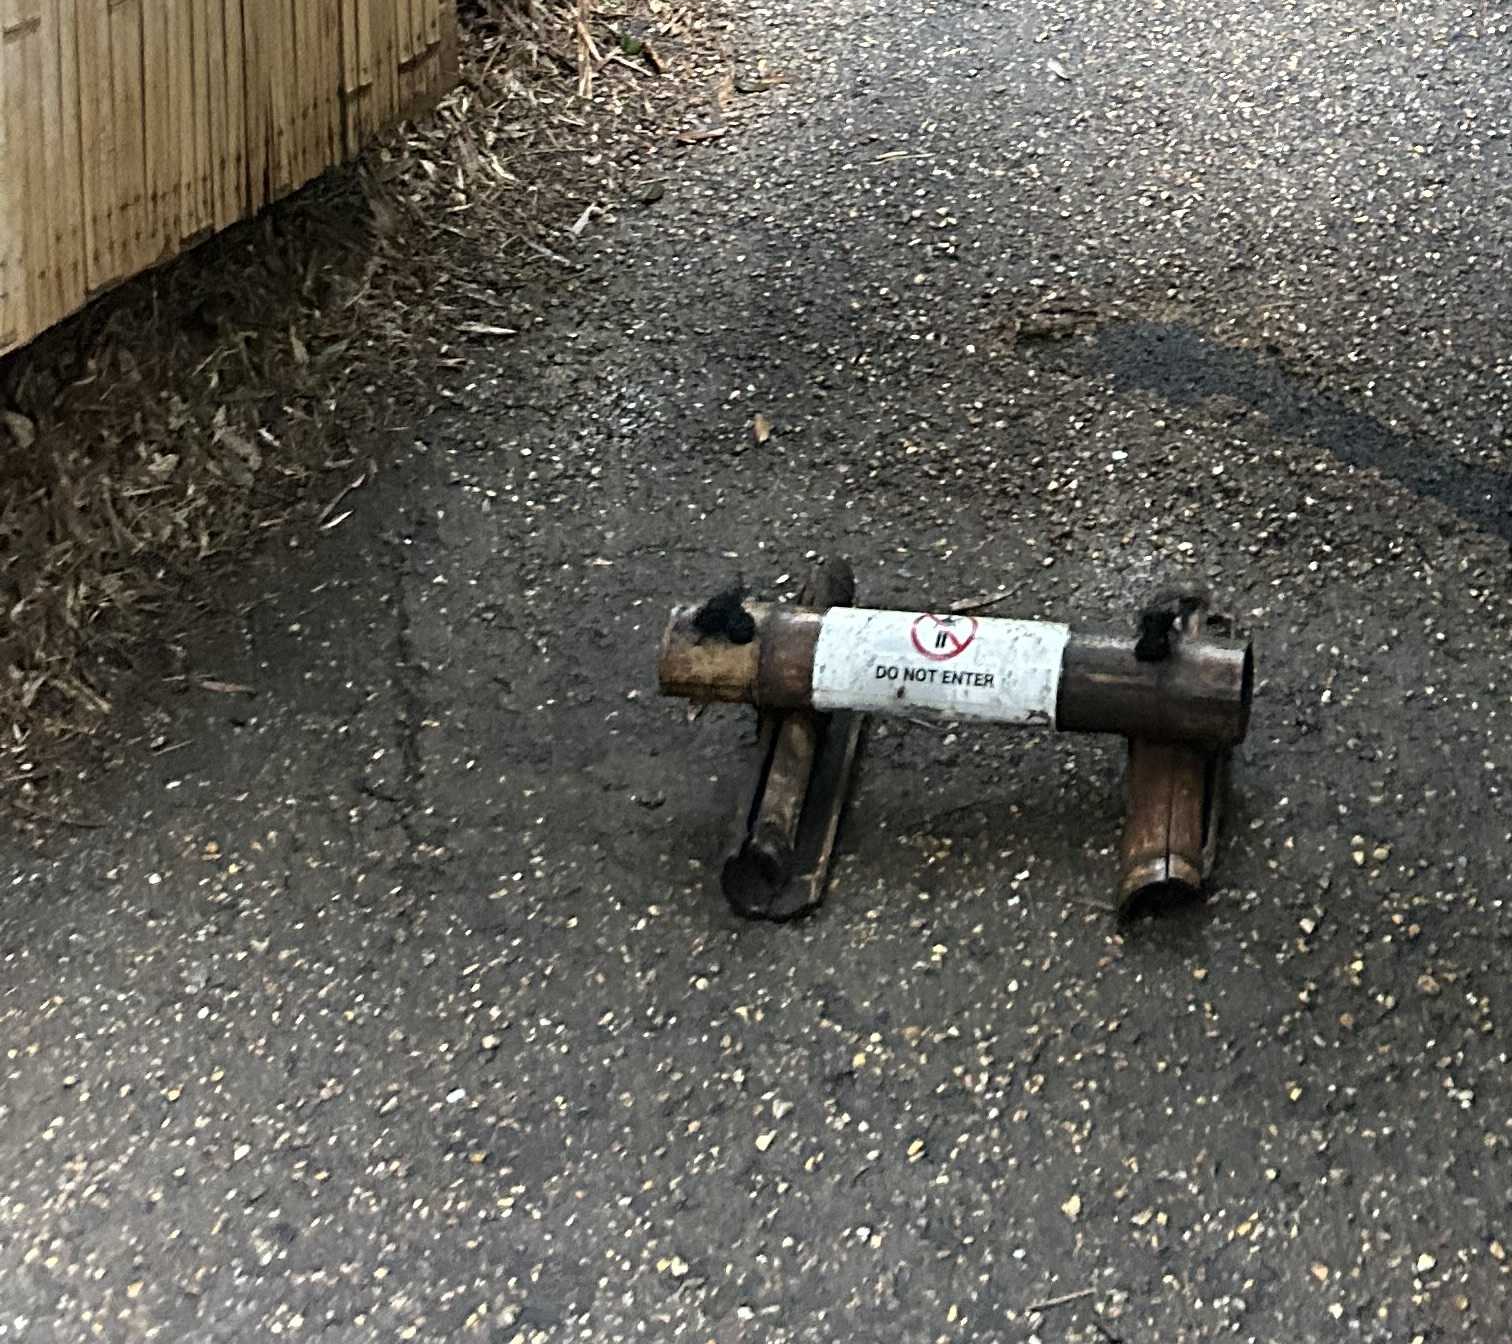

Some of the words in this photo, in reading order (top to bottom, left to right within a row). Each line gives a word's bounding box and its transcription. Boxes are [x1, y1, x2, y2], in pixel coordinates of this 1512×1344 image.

[875, 665, 899, 682] DO
[903, 667, 939, 685] NOT
[942, 670, 994, 688] ENTER
